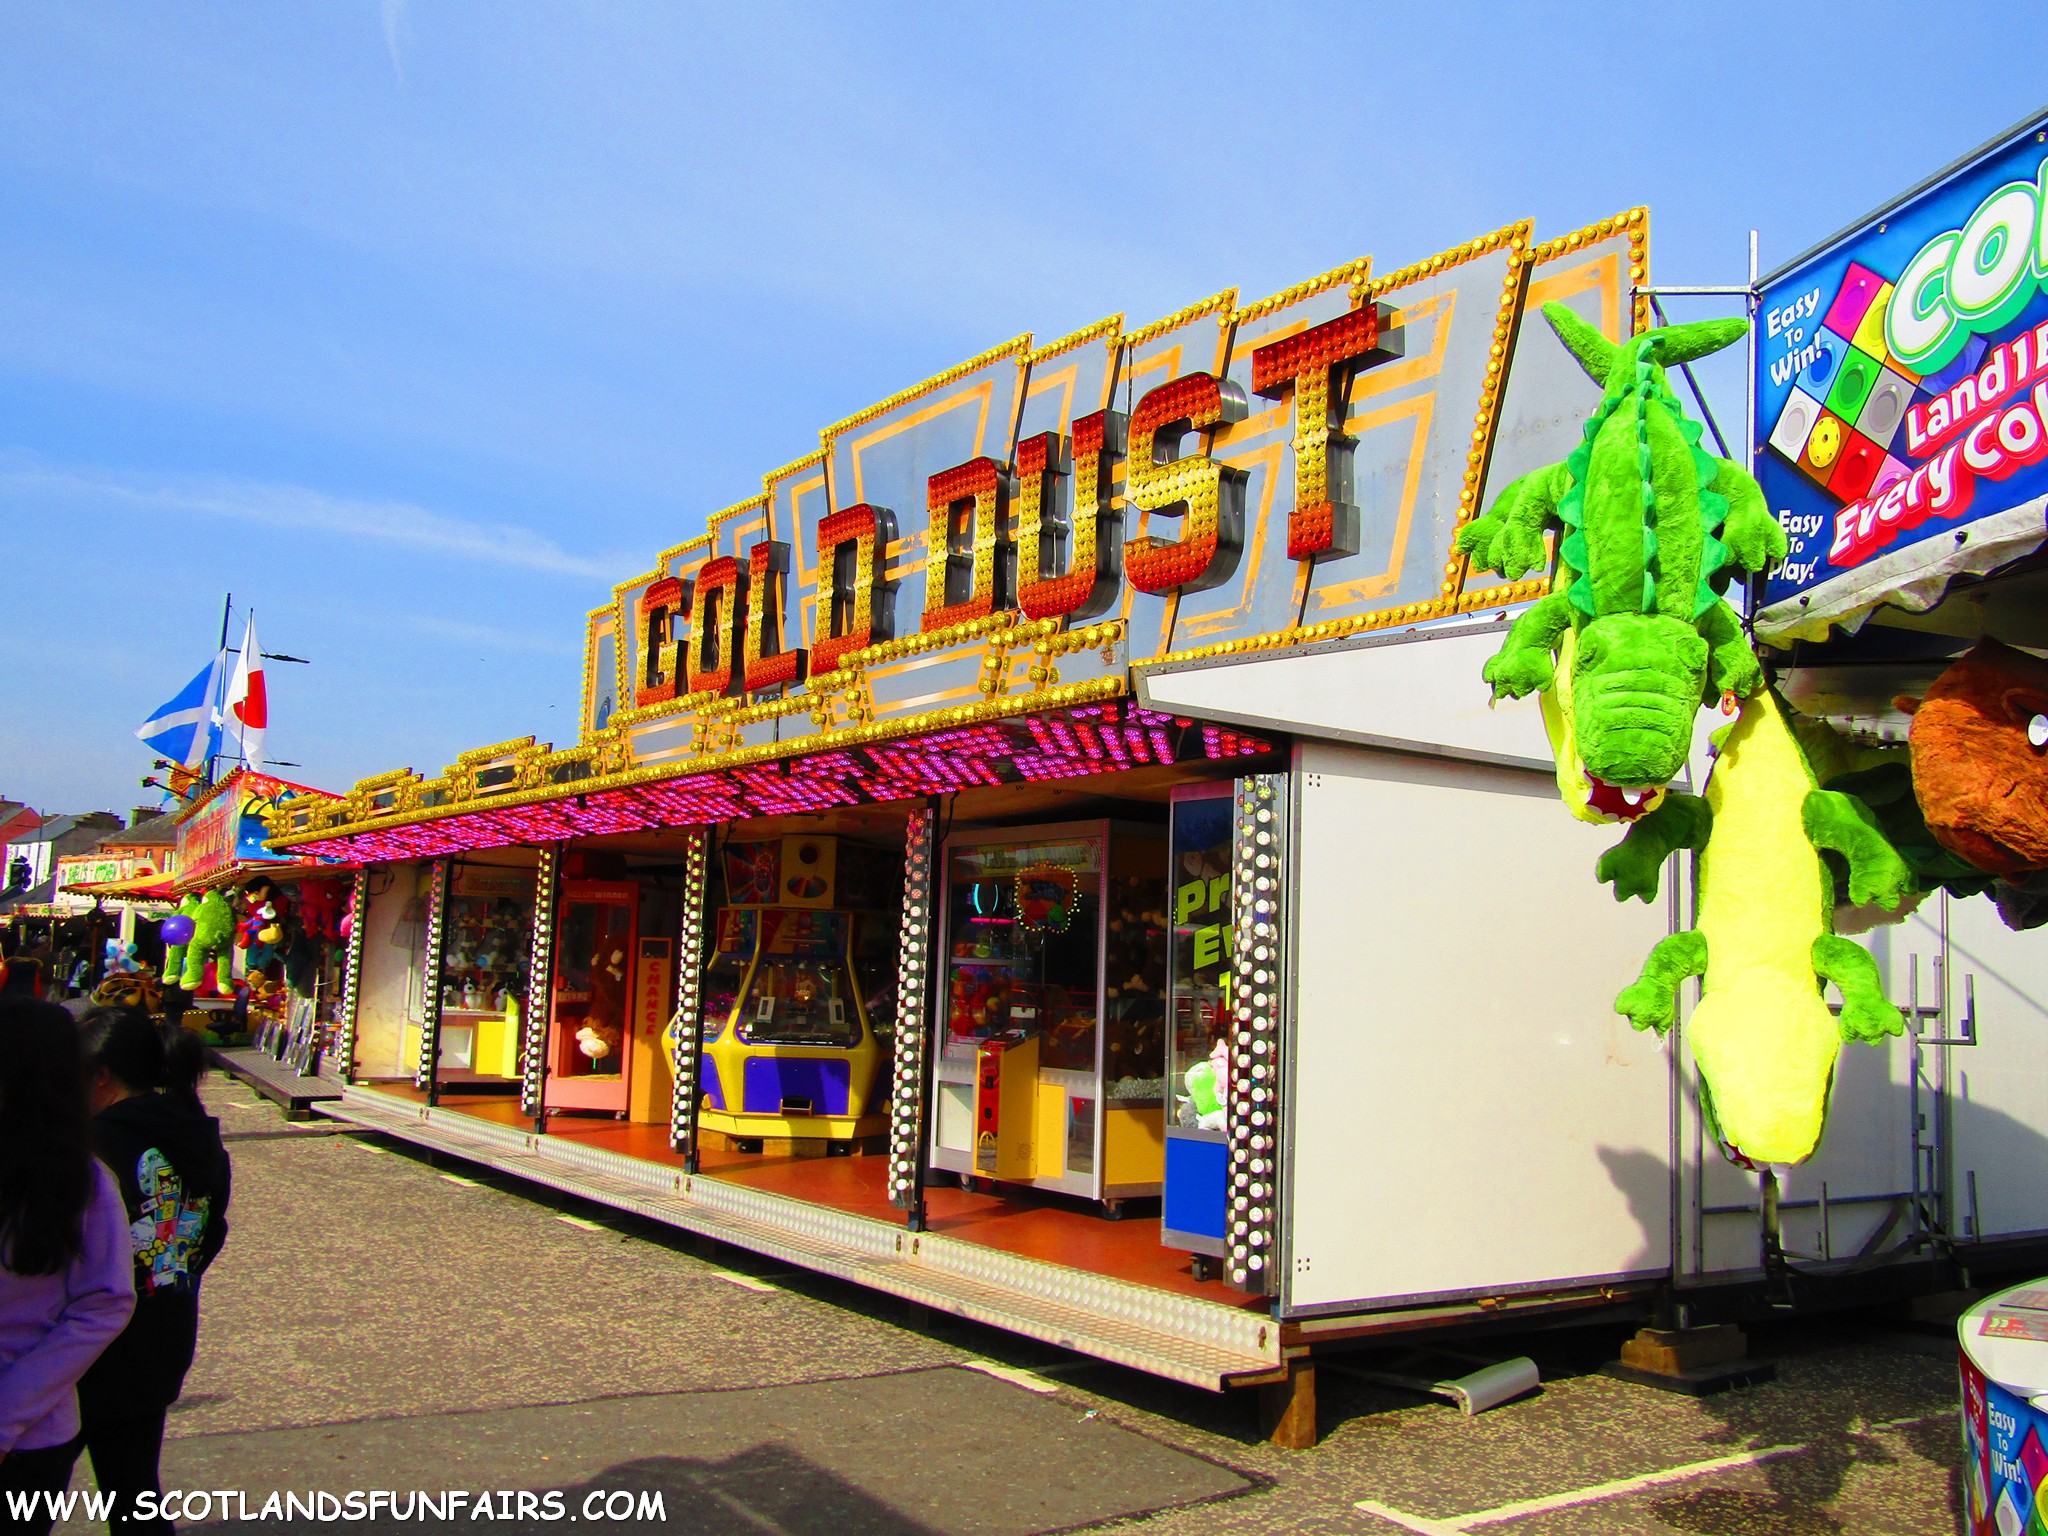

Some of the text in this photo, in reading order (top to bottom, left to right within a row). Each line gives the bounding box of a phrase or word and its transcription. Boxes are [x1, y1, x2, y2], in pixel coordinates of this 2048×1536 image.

[1766, 287, 1820, 340] Easy
[1784, 327, 1803, 349] To
[1770, 330, 1822, 388] Win!
[1906, 343, 2009, 451] Land
[635, 302, 1404, 707] GOLD DUST
[1828, 441, 1961, 560] Every
[1778, 509, 1824, 538] Easy
[1789, 536, 1805, 554] To
[1767, 556, 1819, 585] Play!
[645, 961, 662, 1036] CHANGE
[1988, 1402, 2017, 1439] Easy
[1997, 1432, 2008, 1452] To
[1991, 1449, 2022, 1484] Win!
